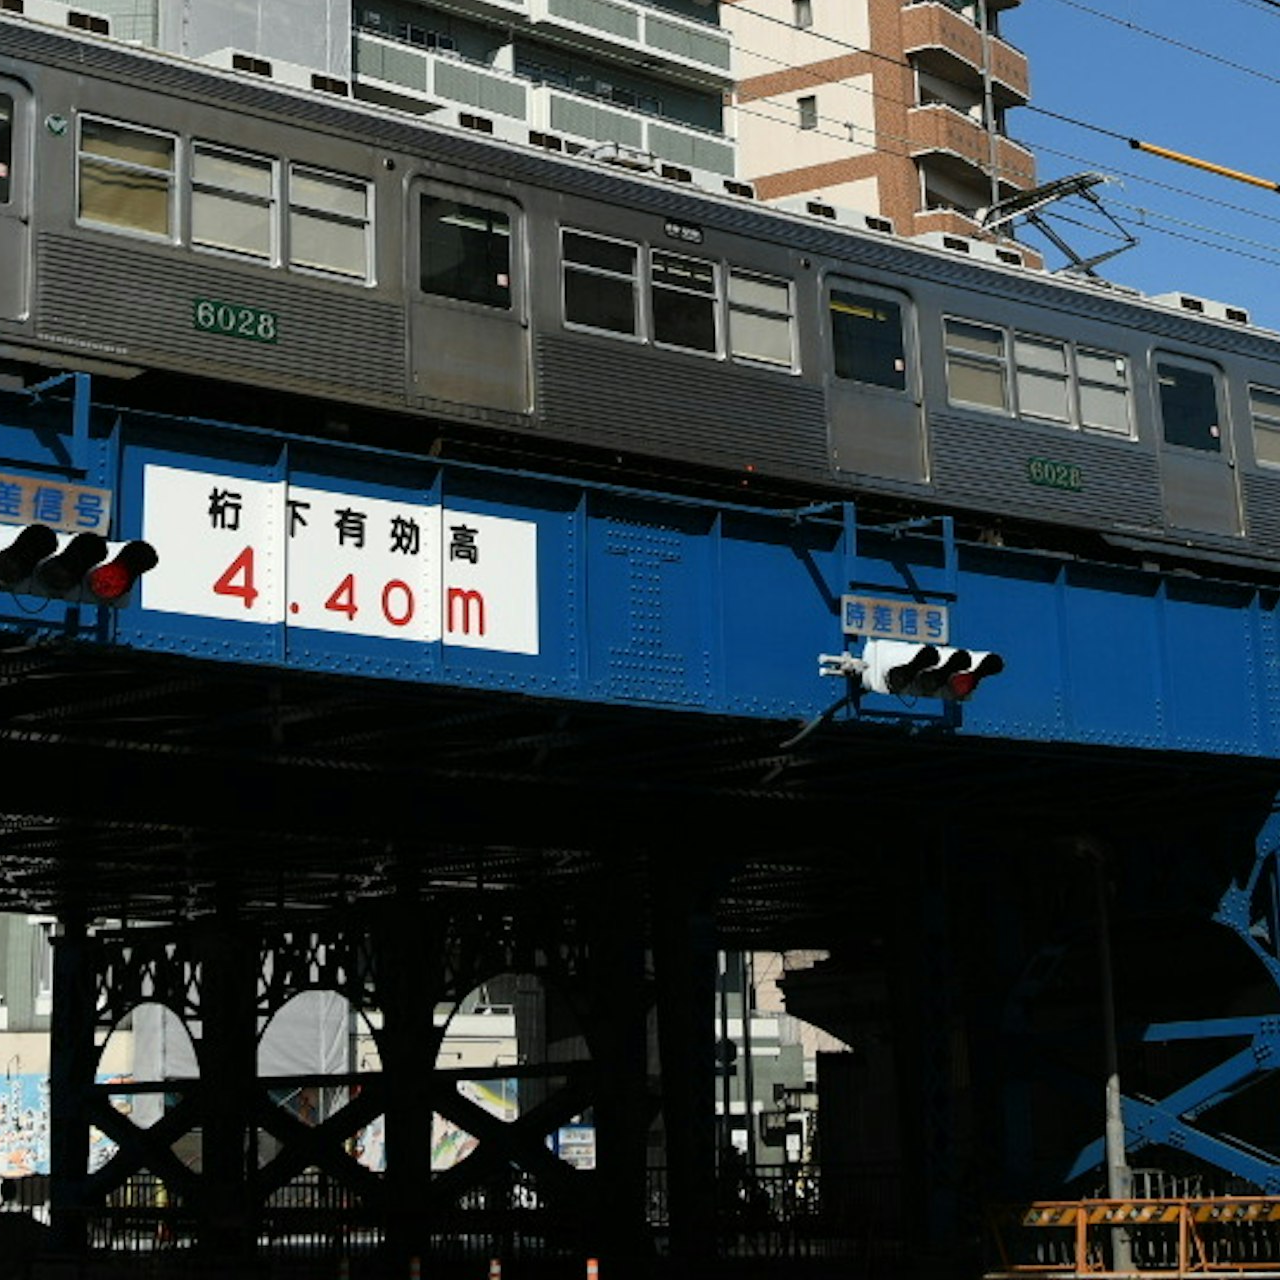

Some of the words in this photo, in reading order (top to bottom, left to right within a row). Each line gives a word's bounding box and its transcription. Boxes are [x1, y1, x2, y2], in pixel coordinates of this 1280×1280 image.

[197, 301, 275, 340] 6028
[208, 487, 479, 564] 桁下有効高
[845, 601, 943, 638] 時差信号
